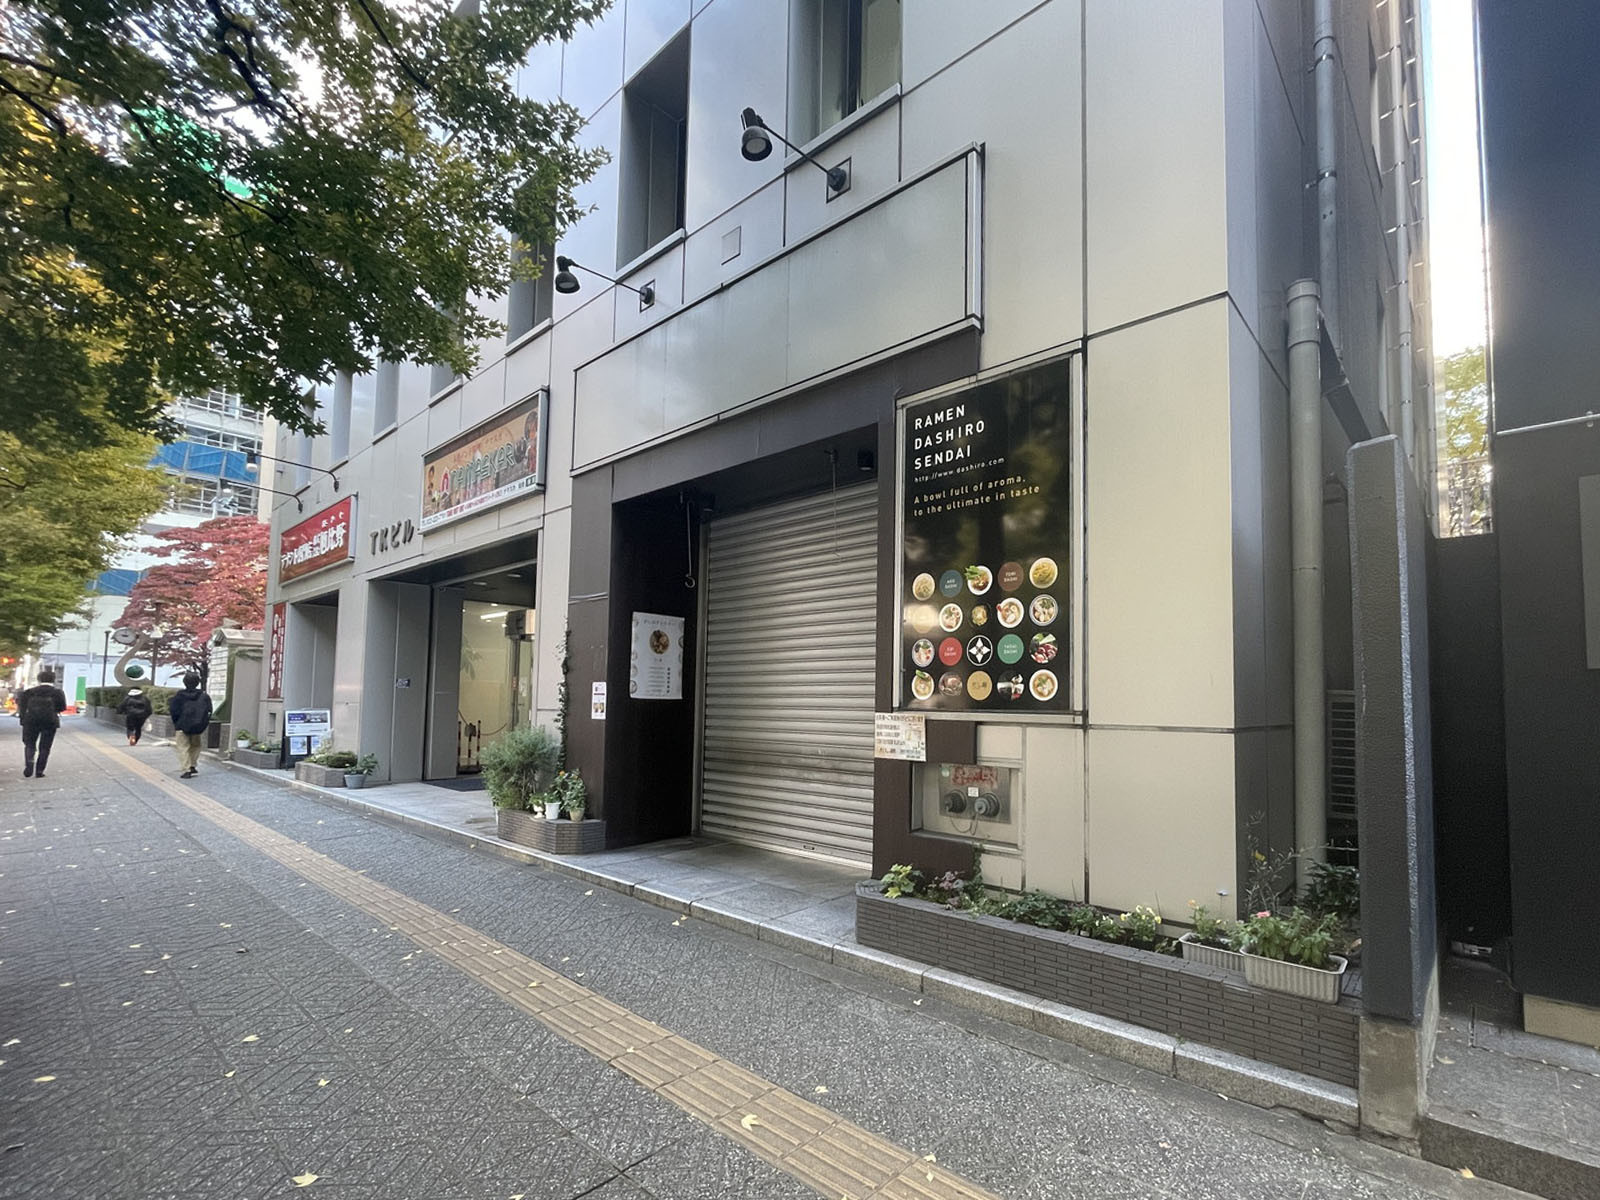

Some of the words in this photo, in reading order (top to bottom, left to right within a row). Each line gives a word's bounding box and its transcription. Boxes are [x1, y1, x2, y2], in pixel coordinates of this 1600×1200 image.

[914, 404, 965, 430] RAMEN
[914, 420, 985, 450] DASHIRO
[914, 444, 971, 470] SENDAI
[914, 457, 1005, 482] http//wwwdashiro.com
[914, 496, 920, 504] A
[923, 490, 945, 502] bowl
[950, 485, 969, 497] full
[972, 482, 983, 492] of
[927, 501, 942, 514] the
[945, 495, 991, 510] ultimate
[995, 491, 1006, 501] in
[1010, 485, 1040, 498] taste
[370, 519, 414, 556] TKビル
